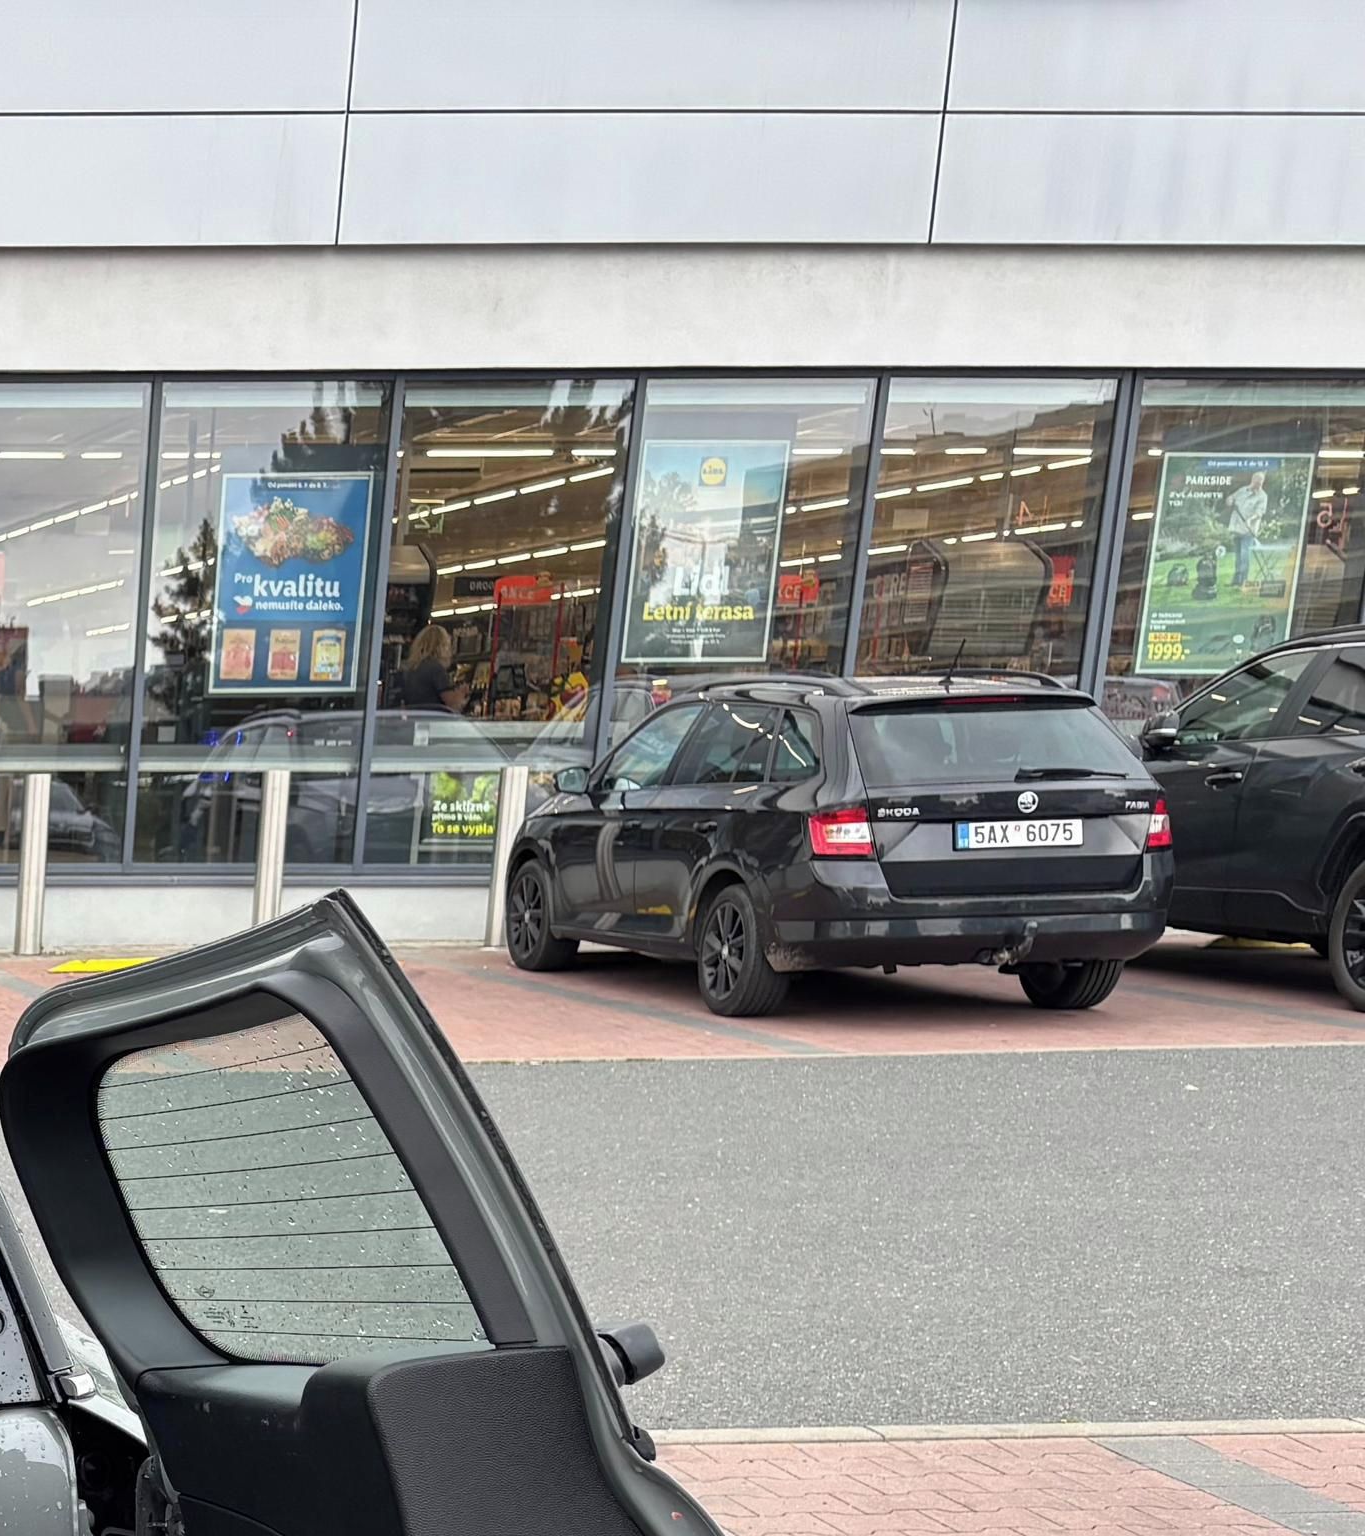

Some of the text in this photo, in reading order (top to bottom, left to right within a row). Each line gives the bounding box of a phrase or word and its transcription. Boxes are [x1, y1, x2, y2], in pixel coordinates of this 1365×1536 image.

[1185, 475, 1232, 486] PARKSIDE
[233, 572, 253, 584] Pro
[673, 566, 730, 596] Lidl
[253, 573, 341, 598] kvalitu
[255, 600, 344, 612] nemusíte daleko.
[642, 601, 755, 621] Letní terasa
[433, 800, 448, 812] Ze
[462, 823, 494, 836] vypla
[974, 824, 1010, 844] 5AX
[1026, 822, 1073, 842] 6075
